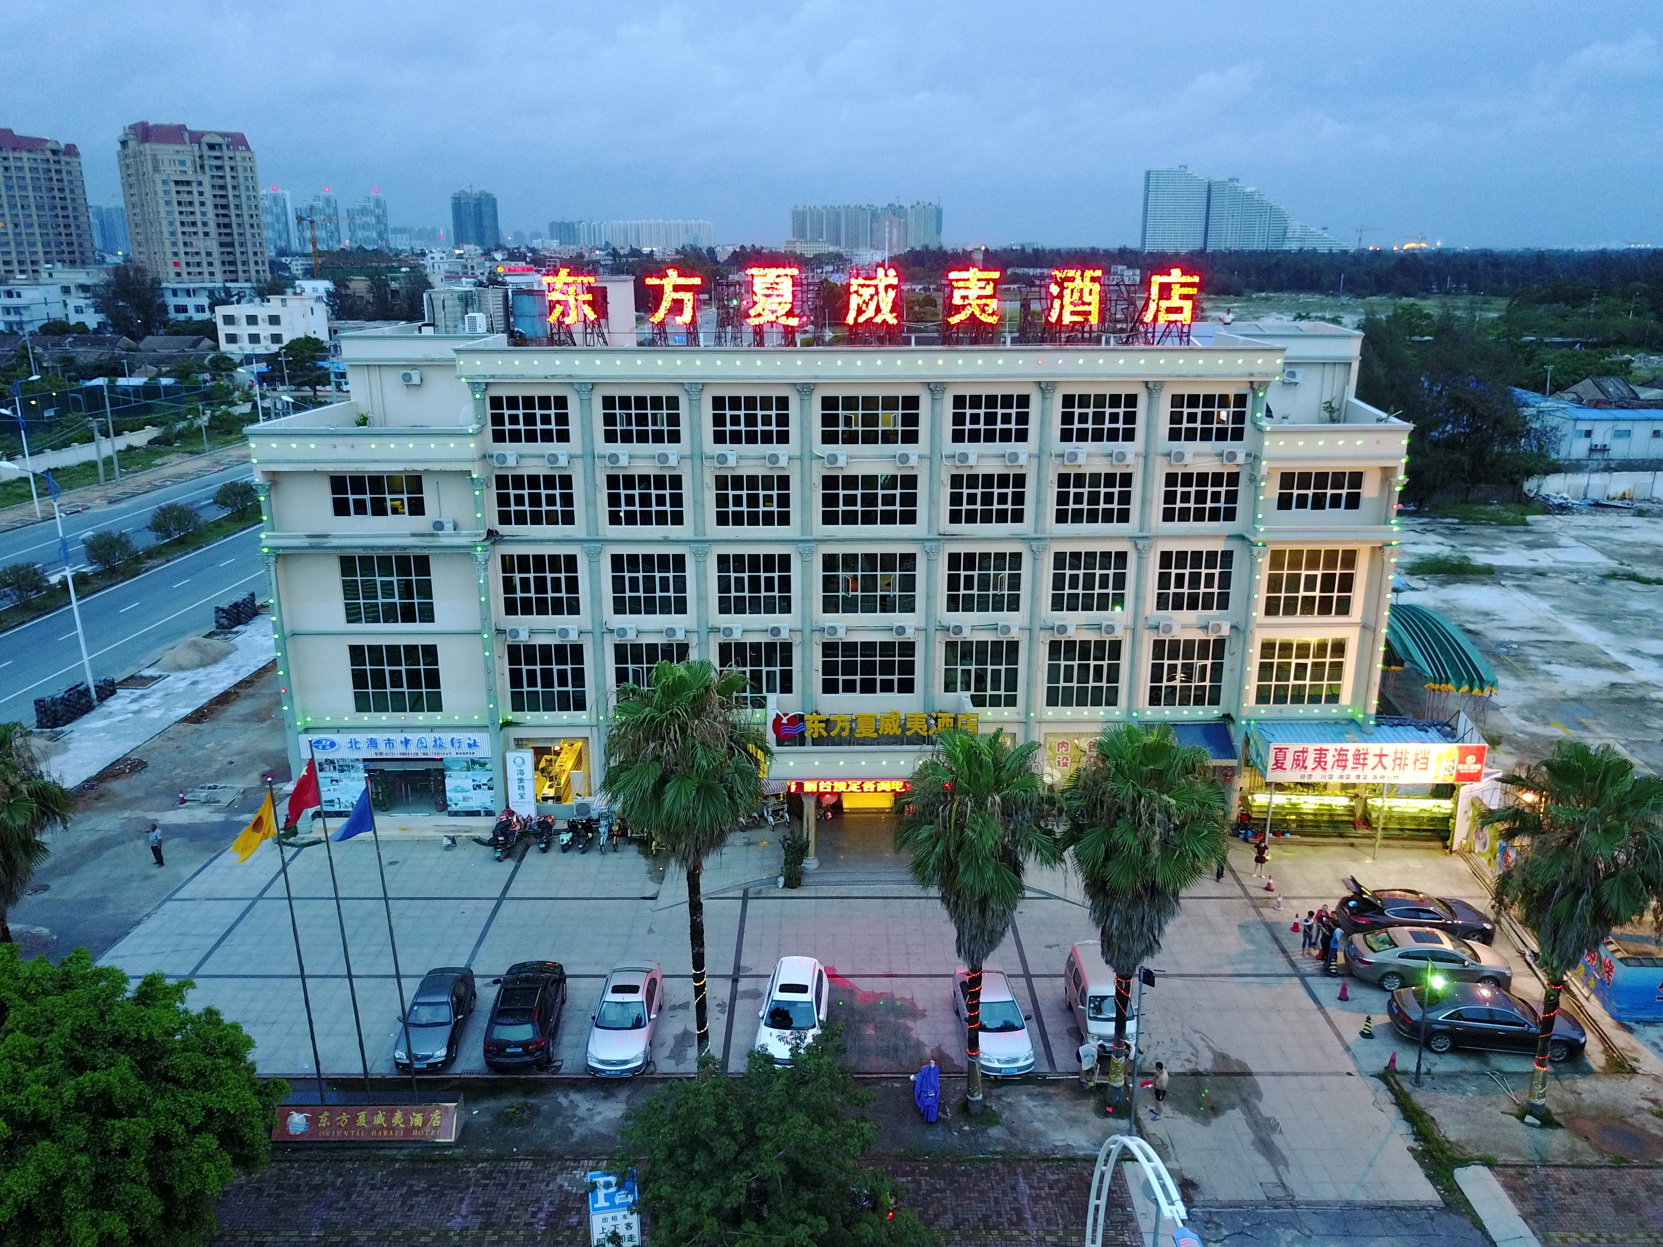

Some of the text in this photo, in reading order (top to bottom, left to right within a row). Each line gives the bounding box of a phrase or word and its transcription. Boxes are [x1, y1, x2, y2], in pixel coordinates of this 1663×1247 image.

[541, 267, 1200, 325] 东方夏威夷酒店
[804, 711, 979, 738] 东方夏威夷酒店
[348, 737, 480, 750] 北海市中国旅行社
[1271, 746, 1431, 771] 夏威夷海鲜大排档
[319, 1109, 442, 1127] 东方夏威夷酒店
[599, 1222, 633, 1234] 上下客
